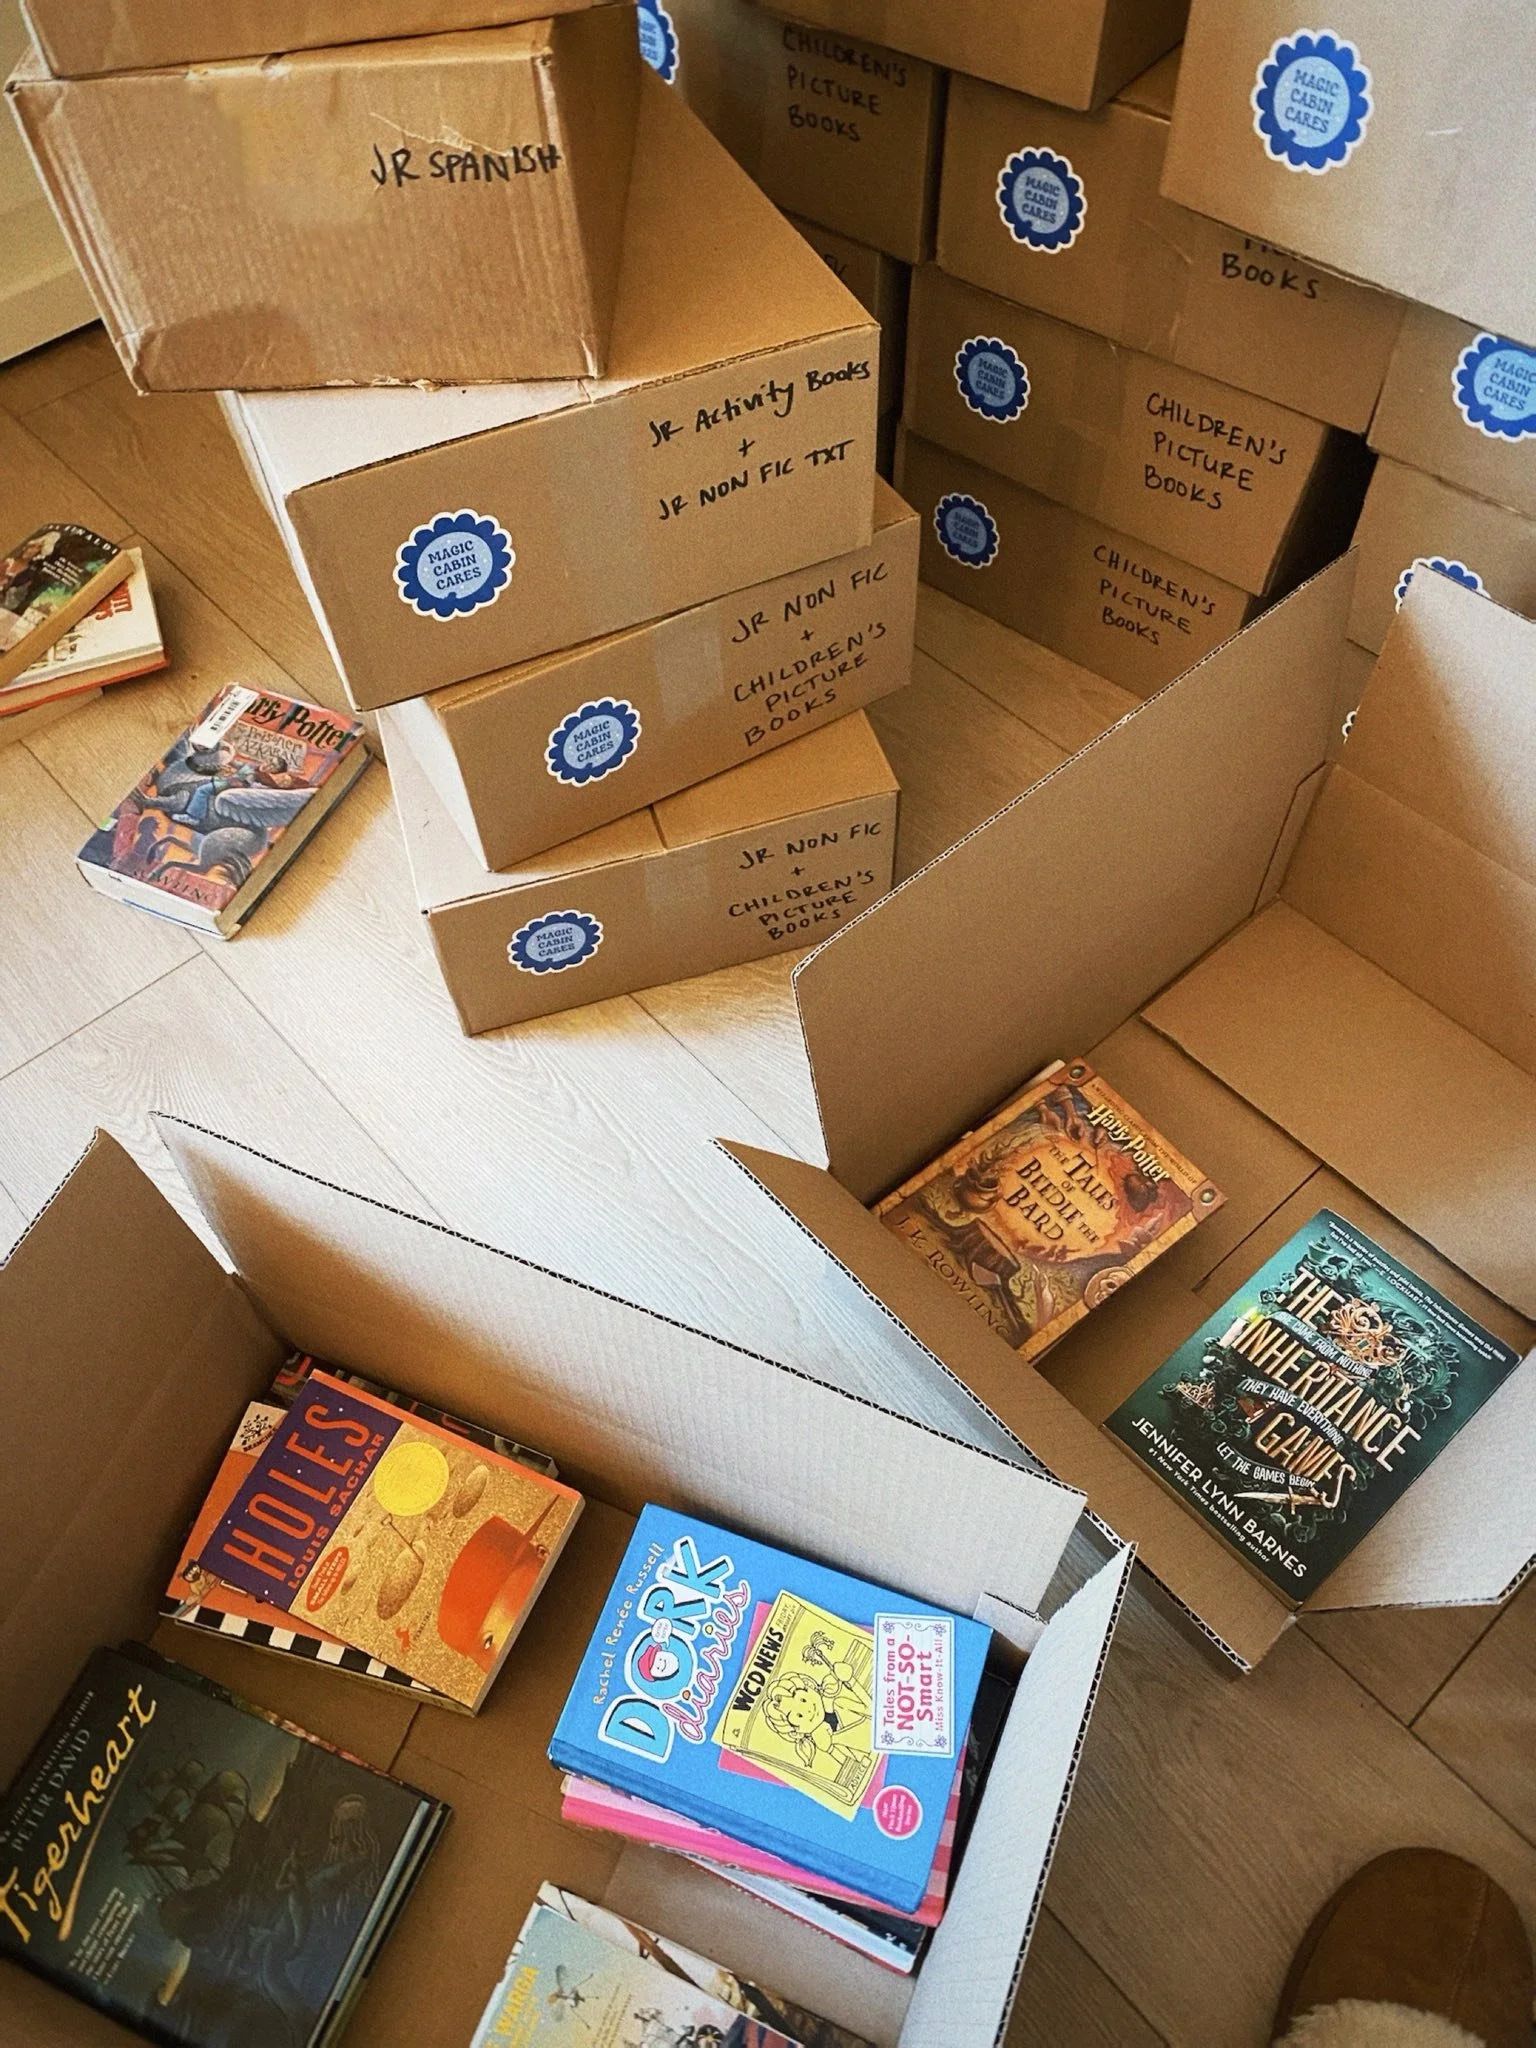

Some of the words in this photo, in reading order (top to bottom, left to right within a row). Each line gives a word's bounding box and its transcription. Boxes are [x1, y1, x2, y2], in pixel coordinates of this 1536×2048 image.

[782, 22, 906, 88] CHILDREN'S
[787, 64, 880, 116] PICTURE
[1290, 88, 1334, 115] CABIN
[1294, 69, 1339, 97] MAGIC
[788, 104, 860, 142] BOOKS
[1284, 106, 1330, 134] CARES
[370, 143, 420, 187] JR
[429, 143, 561, 183] SPANISH
[1025, 175, 1060, 197] MAGIC
[1021, 203, 1057, 224] CARES
[1024, 190, 1058, 211] CABIN
[1221, 252, 1319, 299] BOOKS
[1489, 372, 1531, 397] CABIN
[1494, 358, 1536, 384] MAGIC
[649, 420, 684, 447] JR
[696, 380, 794, 432] Activity
[1483, 386, 1526, 411] CARES
[1146, 392, 1287, 465] CHILDREN'S
[659, 495, 688, 520] JR
[700, 470, 748, 507] NON
[760, 458, 794, 483] FIC
[804, 439, 855, 466] TXT
[1154, 431, 1254, 491] PICTURE
[1144, 463, 1222, 510] BOOKS
[64, 525, 118, 554] INALDI
[427, 540, 474, 563] MAGIC
[433, 553, 477, 577] CABIN
[436, 566, 482, 590] CARES
[1093, 544, 1216, 616] CHILDREN'S
[732, 611, 769, 643] JR
[784, 580, 835, 622] NON
[851, 562, 888, 590] FIC
[1099, 579, 1191, 635] PICTURE
[1102, 606, 1160, 646] BOOKS
[734, 622, 887, 702] CHILDREN'S
[765, 652, 868, 713] PICTURE
[293, 704, 358, 752] Potter
[573, 720, 610, 743] MAGIC
[744, 688, 837, 747] BOOKS
[576, 731, 612, 752] CABIN
[577, 740, 614, 762] CARES
[739, 848, 774, 869] JR
[786, 833, 838, 855] NON
[850, 822, 881, 839] FIC
[728, 870, 875, 917] CHILDREN'S
[759, 890, 858, 926] PICTURE
[767, 908, 841, 940] BOOKS
[1087, 1103, 1131, 1141] Harry
[1121, 1134, 1170, 1183] Potter
[1016, 1156, 1084, 1224] BEEDLE
[1078, 1222, 1099, 1243] THE
[1049, 1145, 1069, 1165] THE
[1063, 1152, 1116, 1211] TALES
[1061, 1180, 1076, 1193] OF
[1003, 1184, 1064, 1241] BARD
[926, 1249, 1010, 1337] ROWLING
[1276, 1265, 1346, 1331] THE
[1315, 1337, 1336, 1360] FROM
[1232, 1316, 1422, 1473] INHERITANCE
[1242, 1379, 1268, 1395] THEY
[1268, 1387, 1297, 1407] HAVE
[1216, 1441, 1235, 1461] LET
[1231, 1454, 1249, 1475] THE
[1253, 1467, 1285, 1485] GAMES
[1255, 1412, 1357, 1509] GAMES
[223, 1404, 370, 1581] HOLES
[288, 1525, 330, 1589] LOUIS
[329, 1433, 385, 1517] SACHAR
[1132, 1417, 1203, 1483] JENNIFER
[1202, 1479, 1246, 1522] LYNN
[1243, 1519, 1308, 1578] BARNES
[1157, 1455, 1173, 1472] New
[1173, 1469, 1189, 1487] York
[1189, 1486, 1209, 1506] Times
[1208, 1504, 1245, 1543] bestselling
[1245, 1540, 1271, 1563] author
[593, 1652, 617, 1705] Rachel
[606, 1600, 633, 1646] Renée
[626, 1542, 665, 1595] Russell
[886, 1638, 895, 1646] a
[600, 1537, 734, 1762] DORK
[661, 1580, 750, 1742] diaries
[732, 1670, 766, 1712] WCD
[753, 1627, 785, 1674] NEWS
[883, 1651, 896, 1683] from
[934, 1638, 944, 1703] Know-It-All
[896, 1634, 916, 1731] NOT-SO-
[916, 1651, 934, 1722] Smart
[883, 1689, 895, 1726] Tales
[935, 1706, 944, 1732] Miss
[10, 1791, 54, 1852] PETER
[48, 1728, 91, 1790] DAVID
